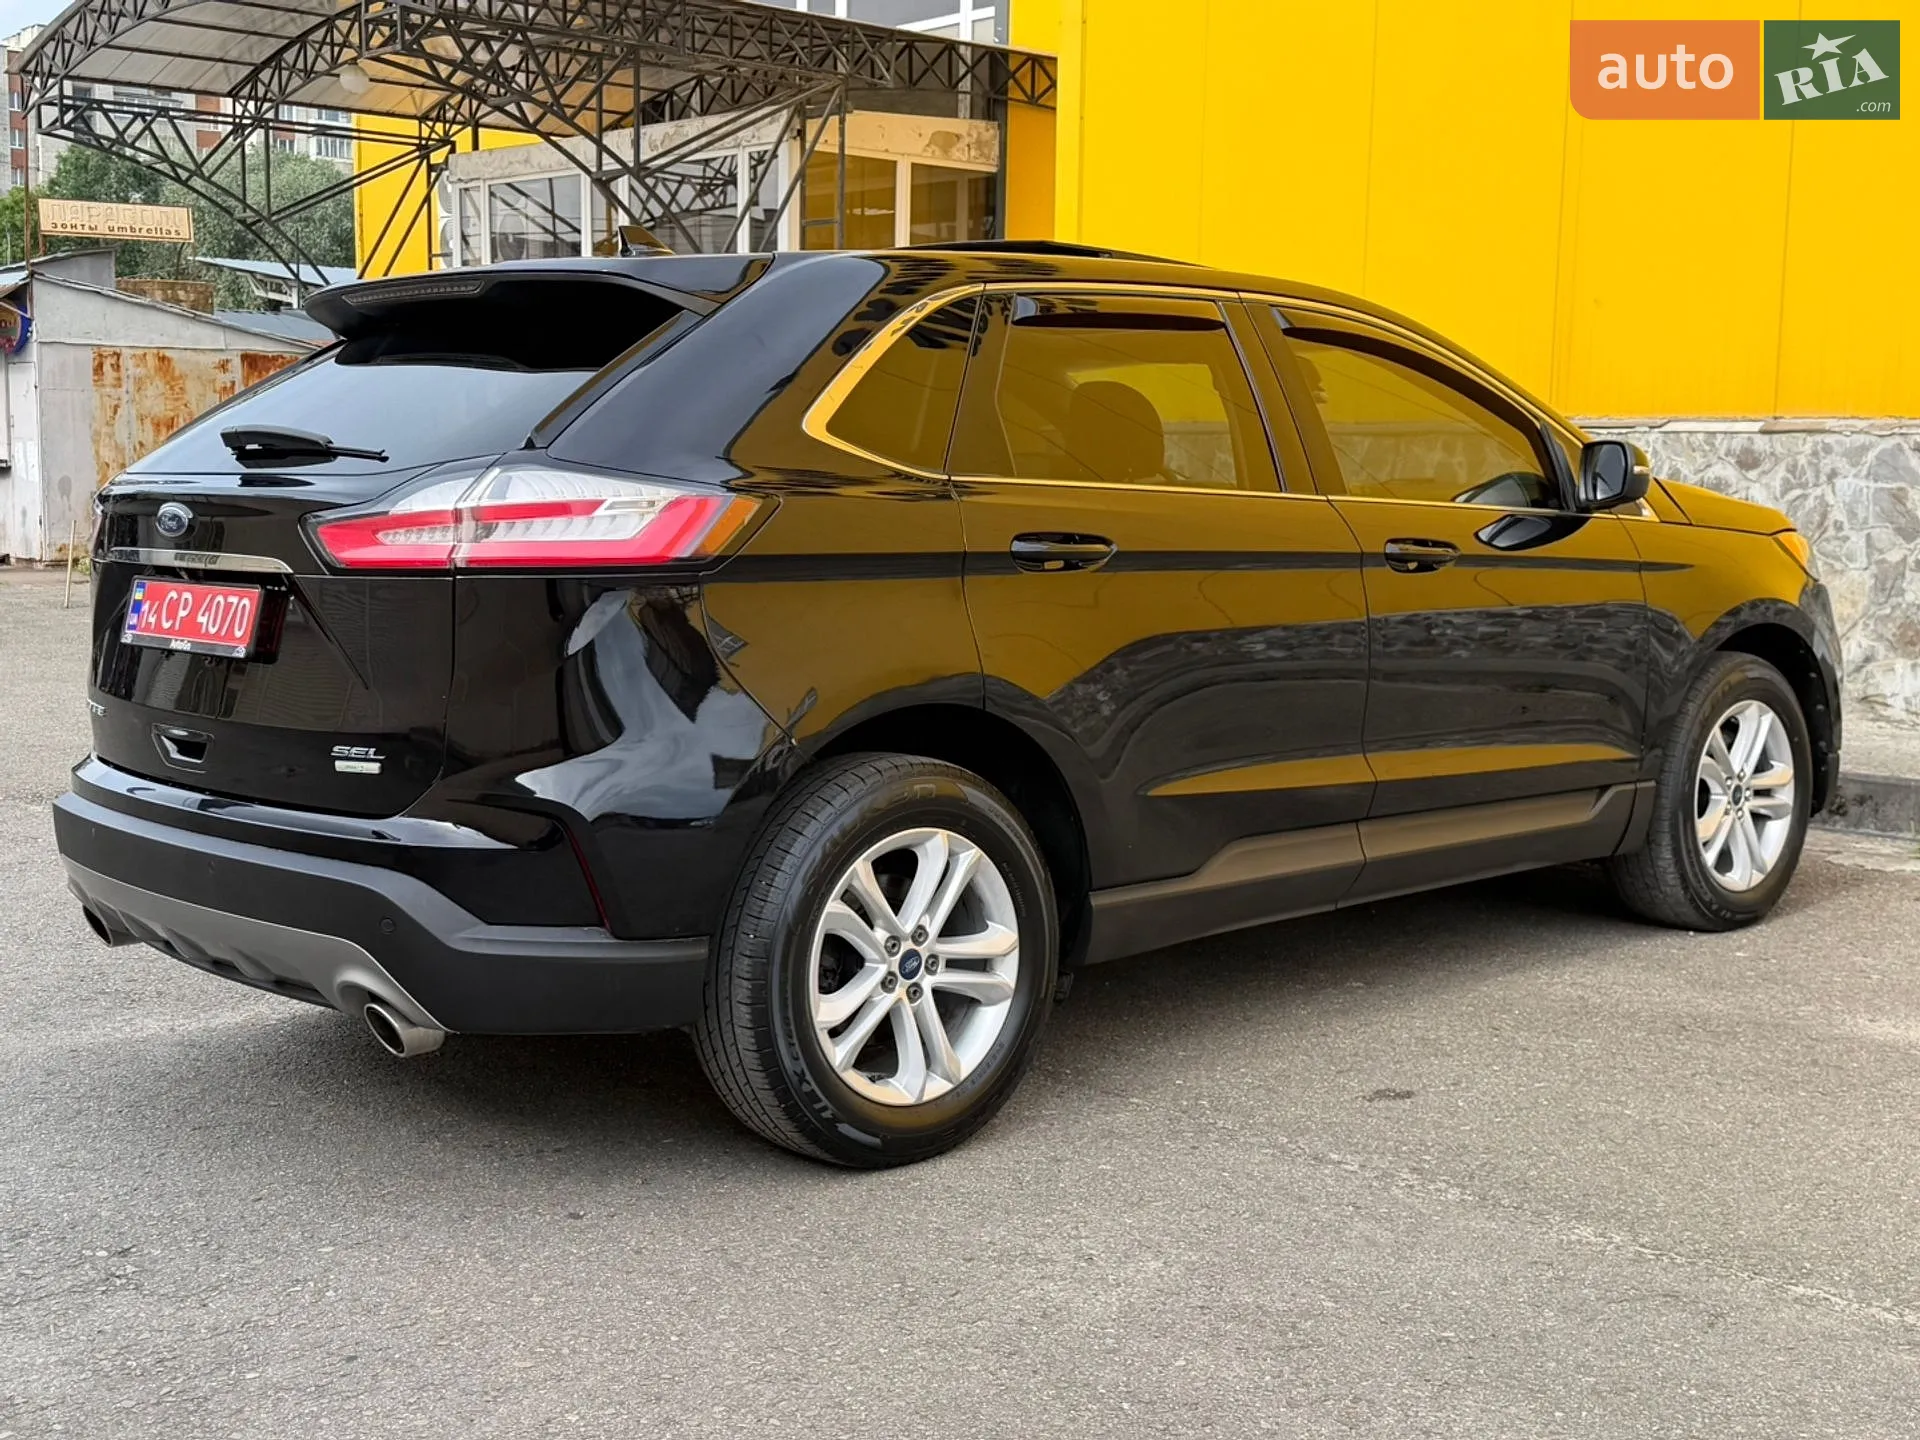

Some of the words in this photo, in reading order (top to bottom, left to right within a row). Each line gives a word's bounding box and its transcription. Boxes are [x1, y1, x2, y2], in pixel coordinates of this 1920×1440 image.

[51, 222, 98, 231] зонты
[108, 224, 181, 236] umbrellas
[197, 593, 251, 639] 4070
[330, 745, 386, 760] SEL
